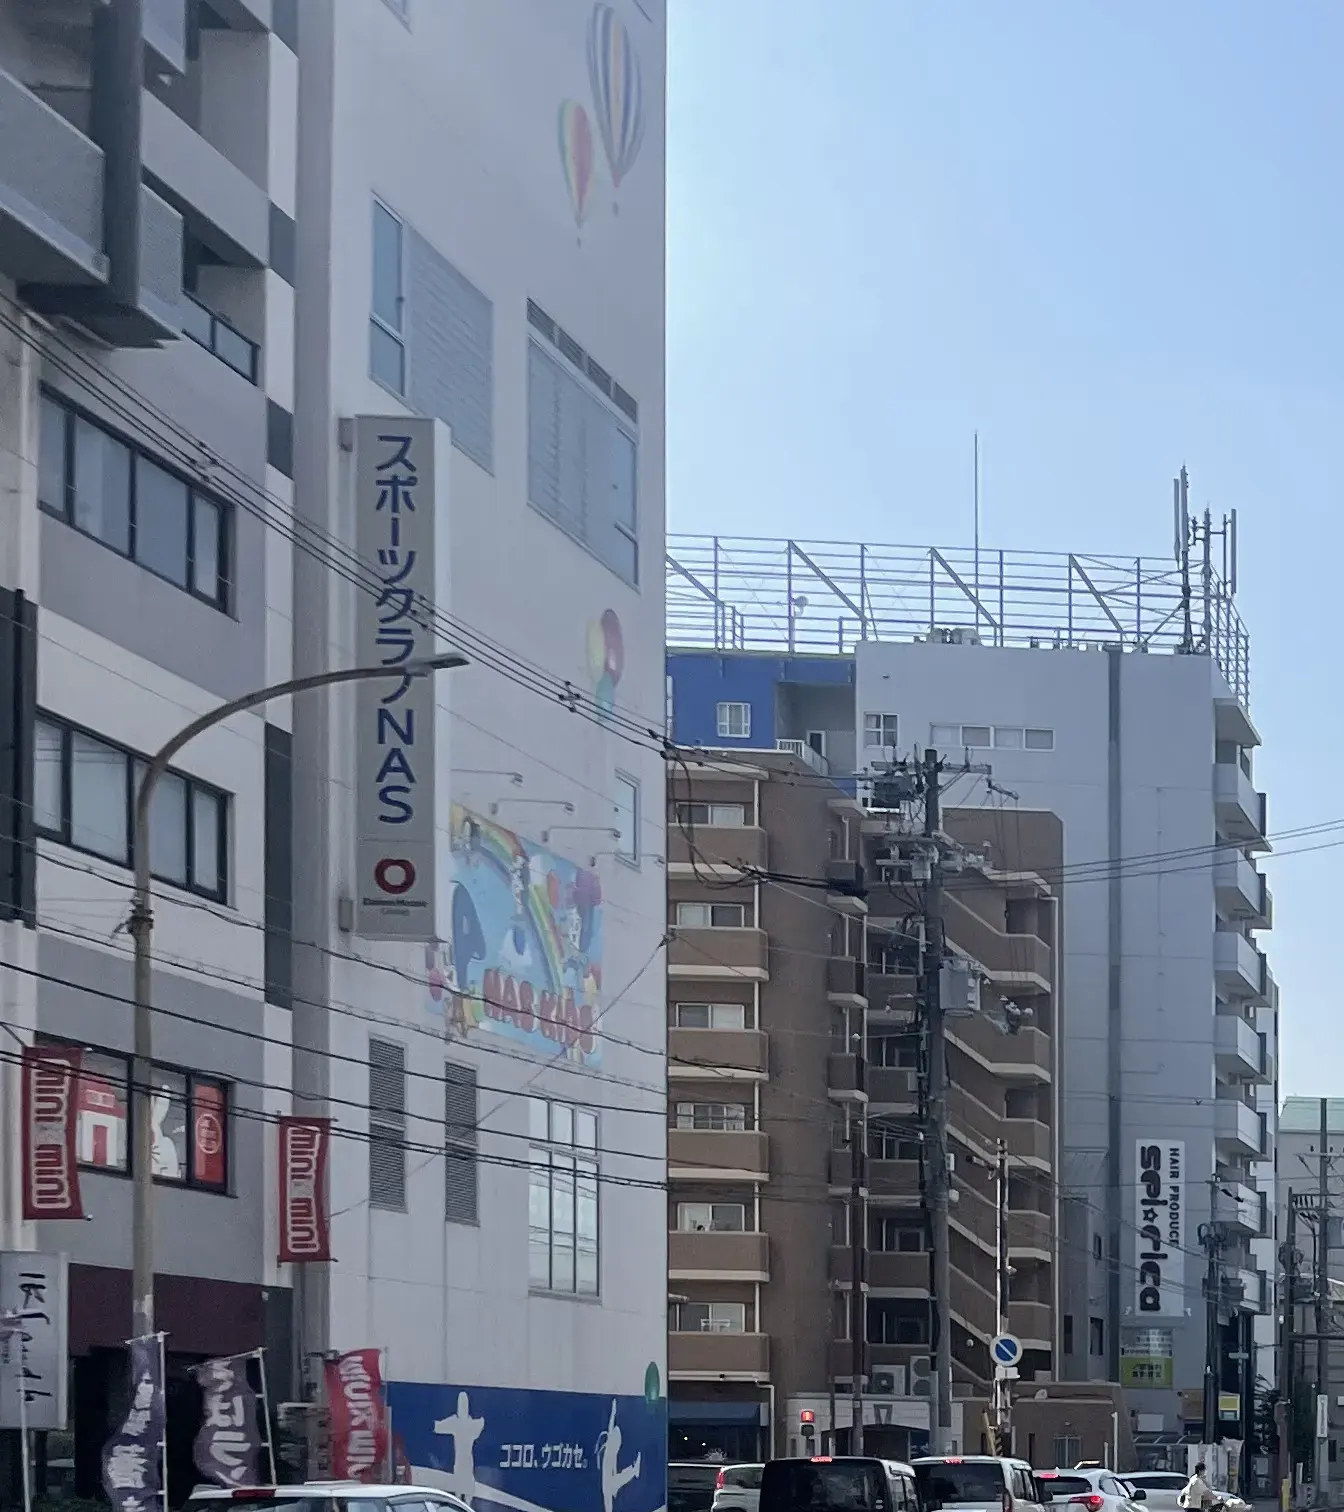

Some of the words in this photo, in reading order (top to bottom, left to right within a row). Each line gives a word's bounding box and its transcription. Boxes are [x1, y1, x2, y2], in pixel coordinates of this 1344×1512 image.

[32, 1143, 71, 1209] mini
[1168, 1147, 1181, 1180] HAIR
[288, 1197, 319, 1250] mini
